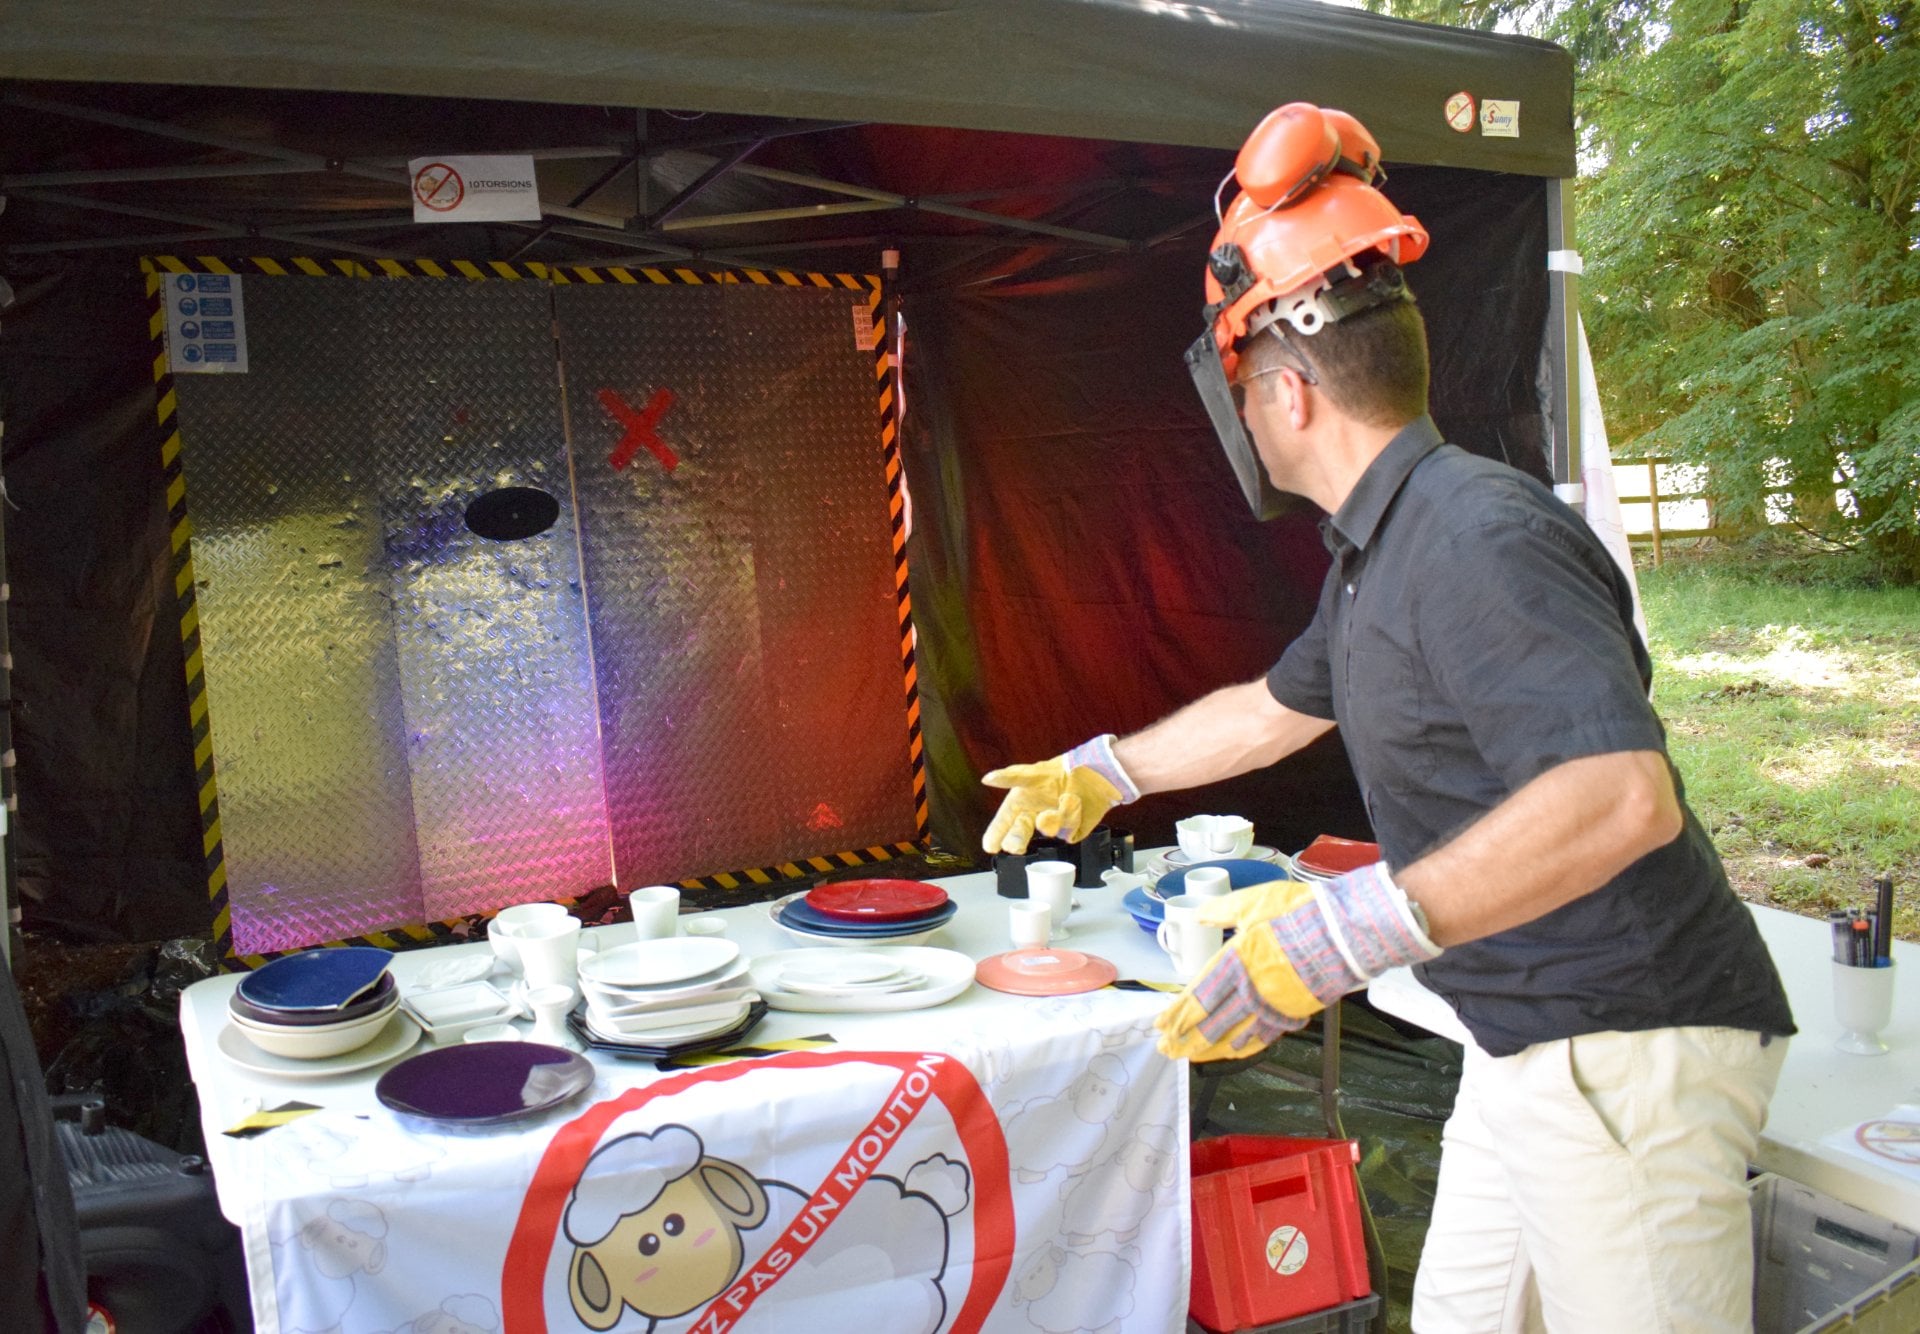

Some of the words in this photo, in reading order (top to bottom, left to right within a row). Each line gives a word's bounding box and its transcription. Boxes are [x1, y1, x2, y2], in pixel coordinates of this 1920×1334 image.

[469, 180, 532, 188] 10TORSIONS
[724, 1247, 793, 1311] PAS
[790, 1191, 841, 1244] UN
[834, 1053, 946, 1193] MOUTON
